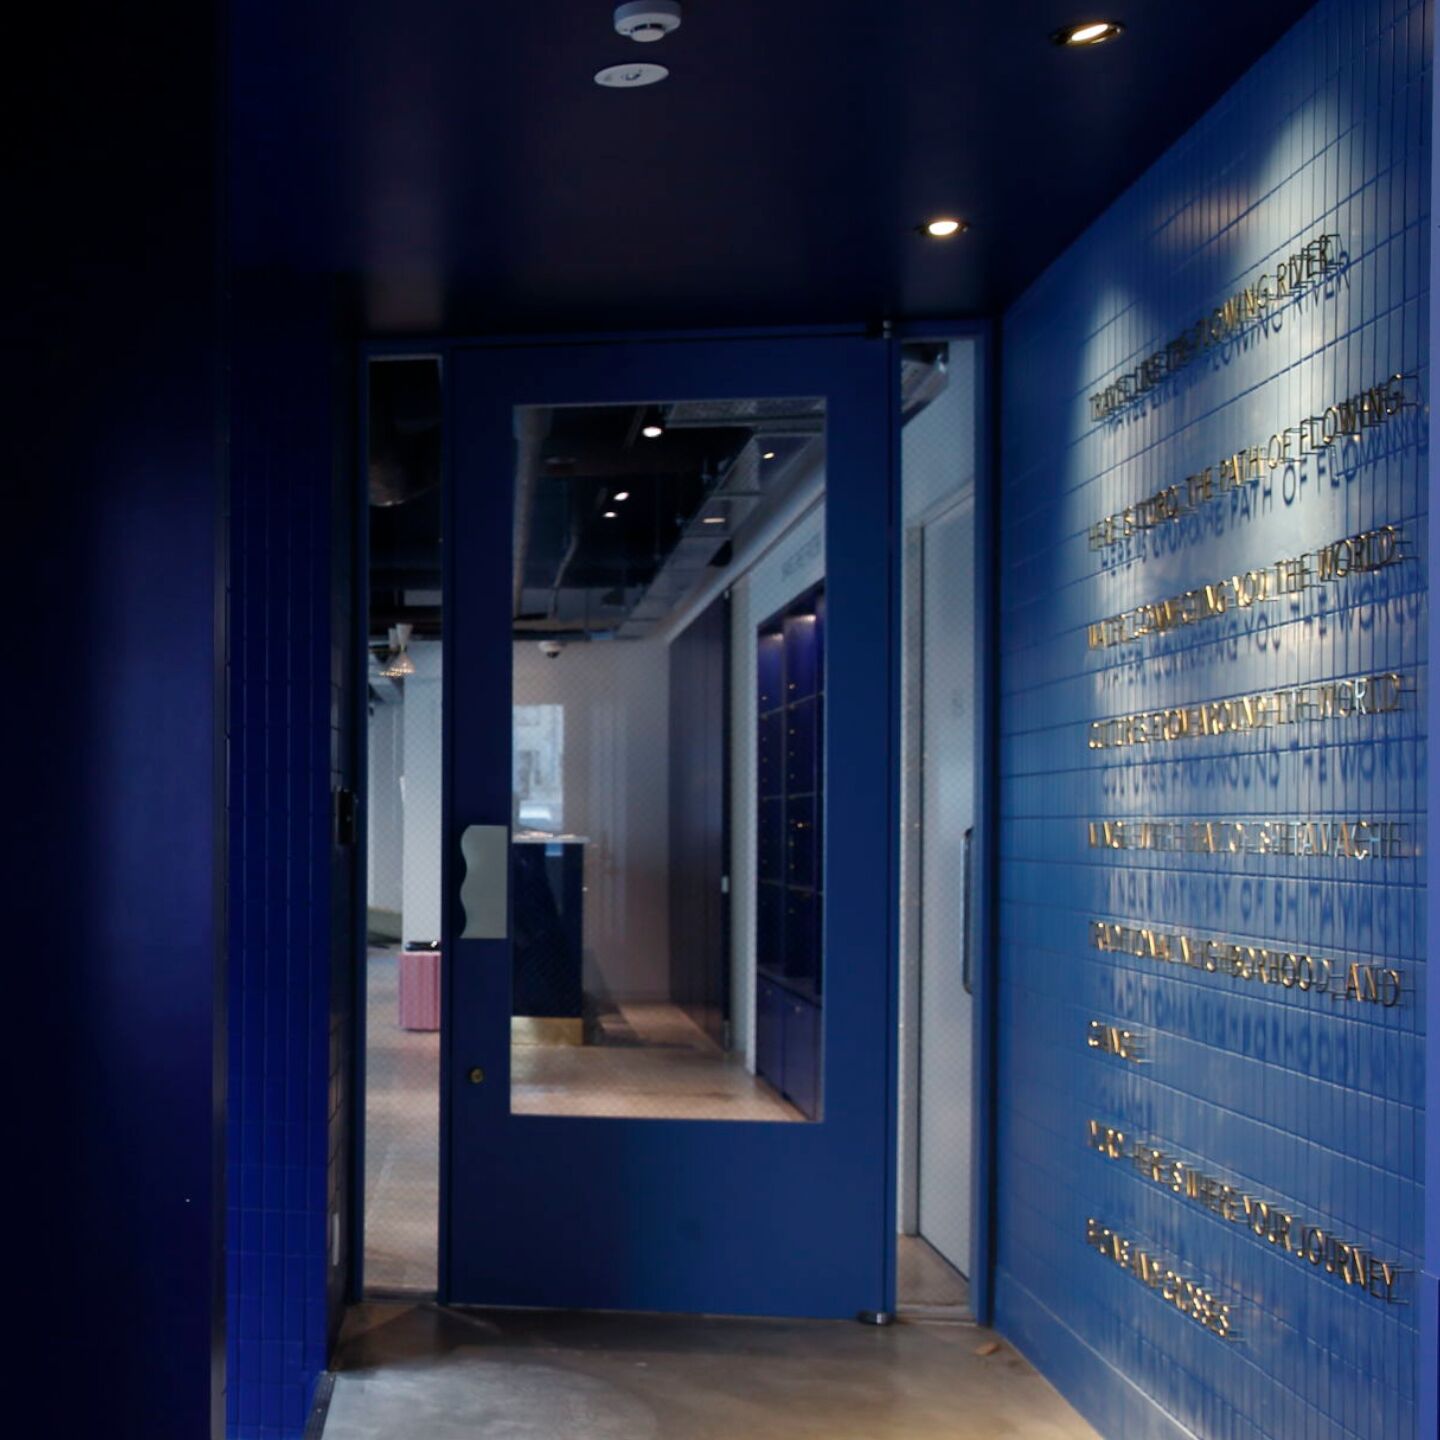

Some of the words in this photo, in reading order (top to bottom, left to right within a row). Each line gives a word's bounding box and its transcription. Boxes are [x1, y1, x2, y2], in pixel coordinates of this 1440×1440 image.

[1277, 235, 1330, 298] RIVER
[1187, 467, 1212, 502] THE
[1220, 446, 1265, 490] PATH
[1268, 429, 1291, 469] OF
[1300, 374, 1403, 454] FLOWING
[1318, 525, 1396, 580] WORLD
[1317, 672, 1401, 719] WORLD
[1347, 962, 1400, 1006] AND
[1243, 1194, 1292, 1252] YOUR
[1296, 1226, 1394, 1303] JOURNEY
